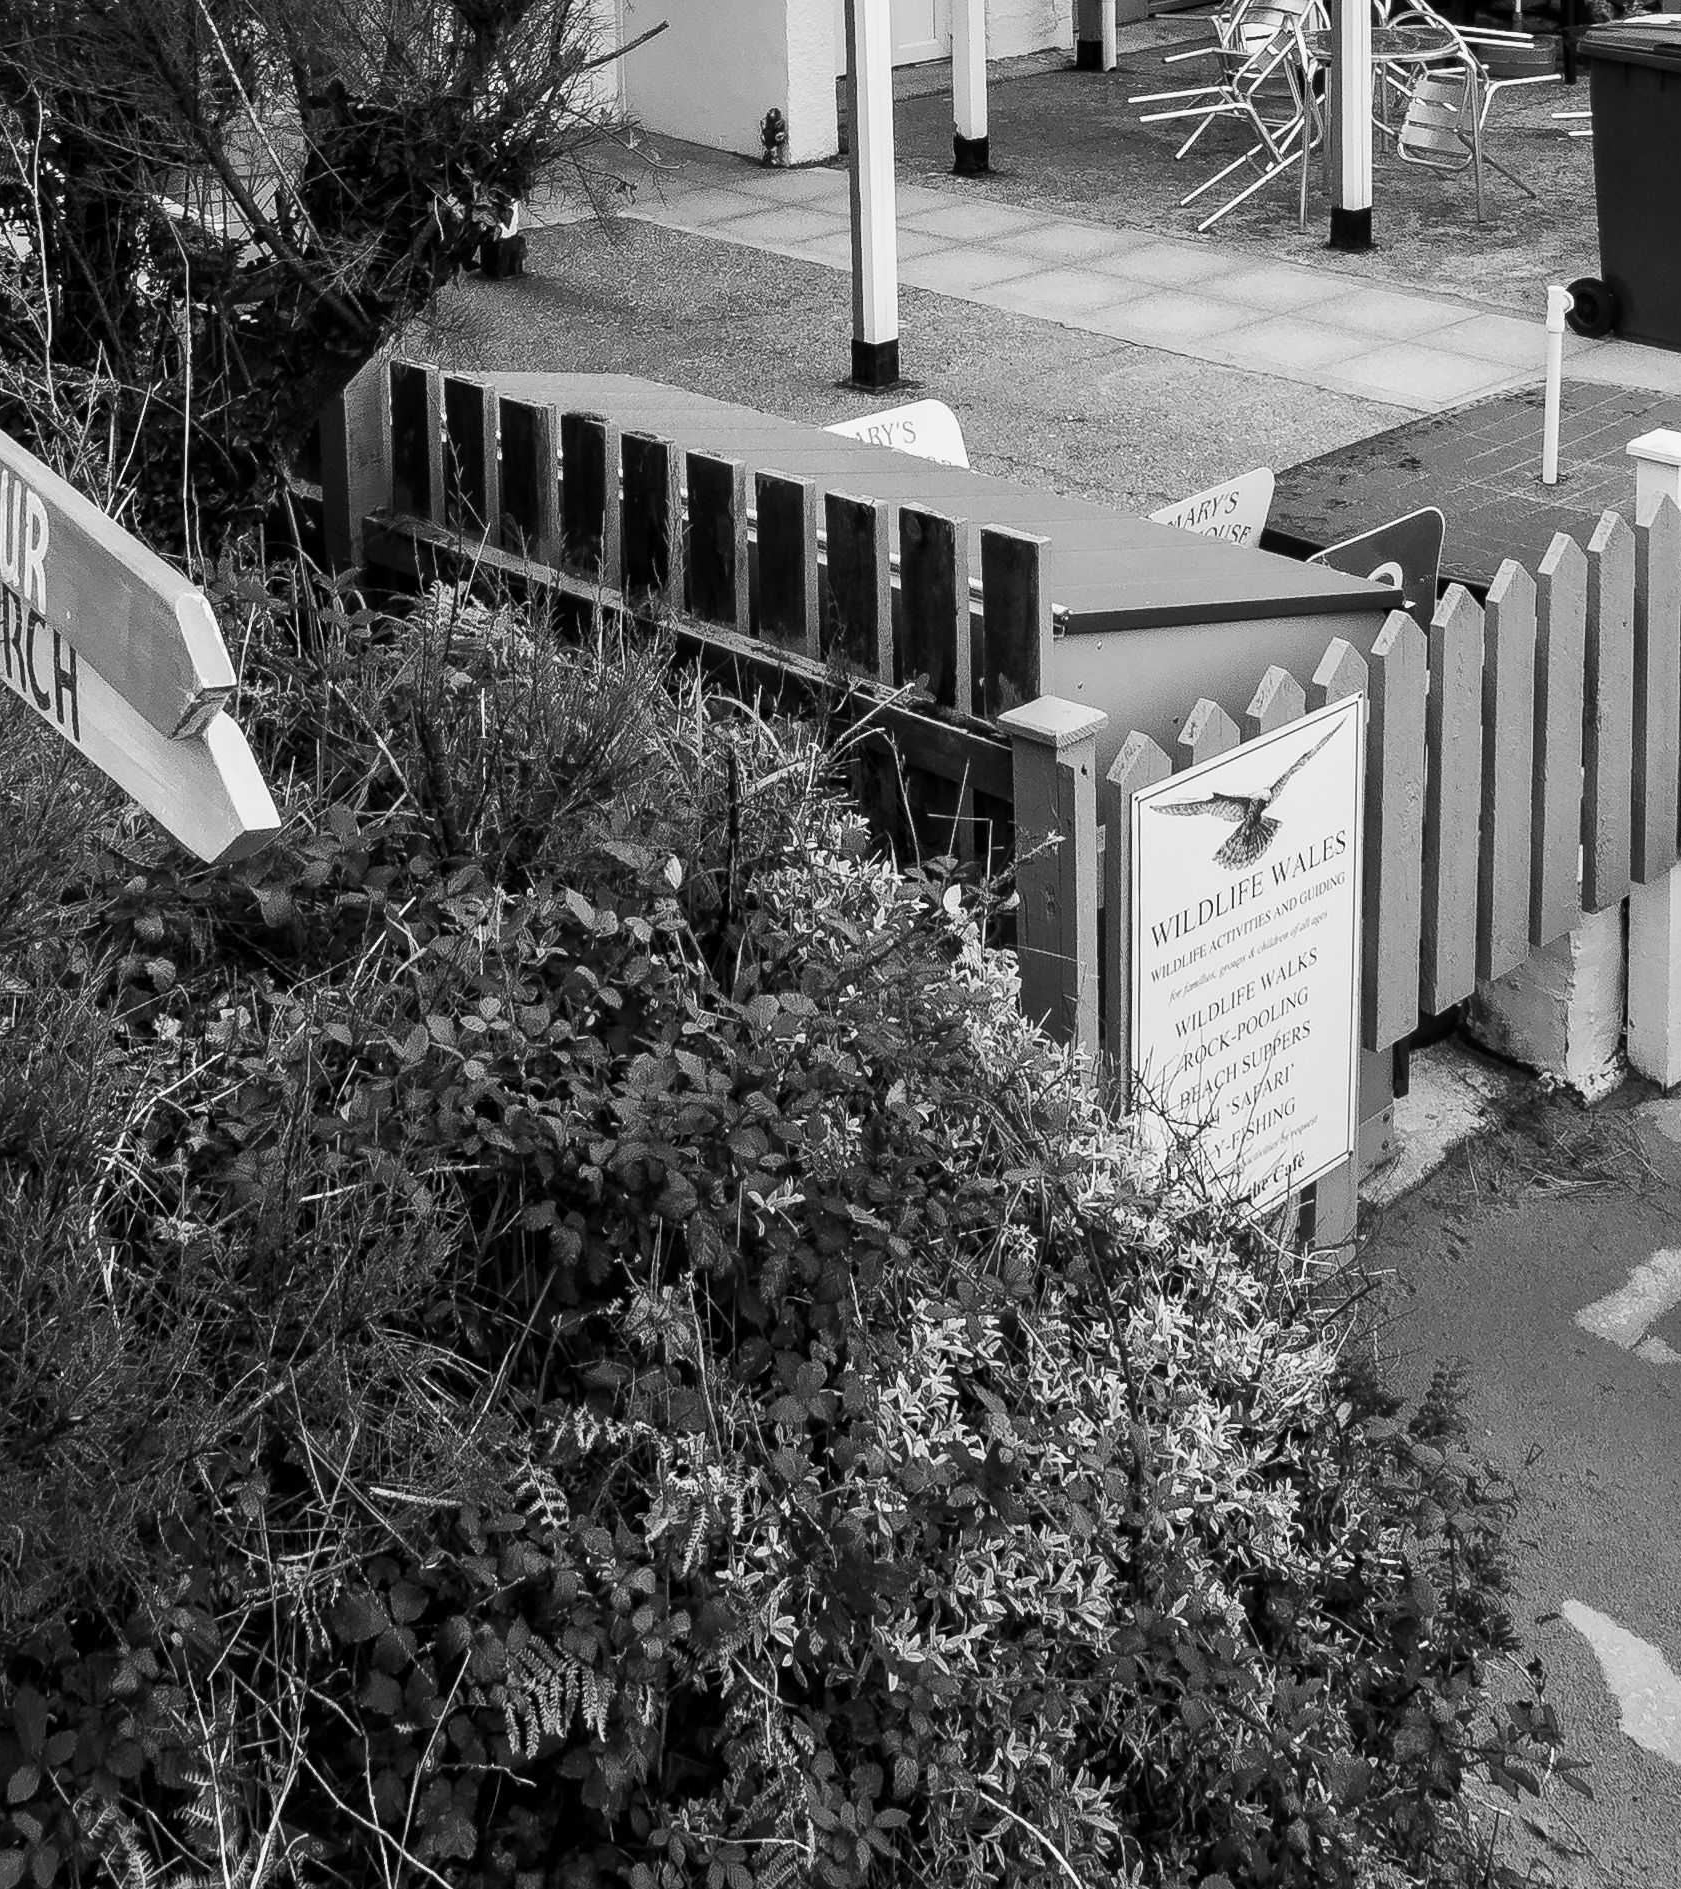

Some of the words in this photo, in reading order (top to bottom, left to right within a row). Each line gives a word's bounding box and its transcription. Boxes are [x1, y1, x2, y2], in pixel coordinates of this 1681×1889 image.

[856, 421, 917, 446] ARY'S
[1201, 523, 1252, 545] OUSE
[1150, 944, 1207, 983] WILDLIFE
[1208, 910, 1272, 956] ACTIVITIES
[1272, 896, 1298, 920] AND
[1299, 871, 1346, 905] GUIDING
[1151, 871, 1264, 948] WILDLIFE
[1270, 830, 1347, 886] WALES
[1174, 980, 1256, 1039] WILDLIFE
[1260, 946, 1318, 992] WALKS
[1183, 985, 1309, 1072] ROCK-POOLING
[1180, 1060, 1238, 1110] BEACH
[1242, 1020, 1311, 1075] SUPPERS
